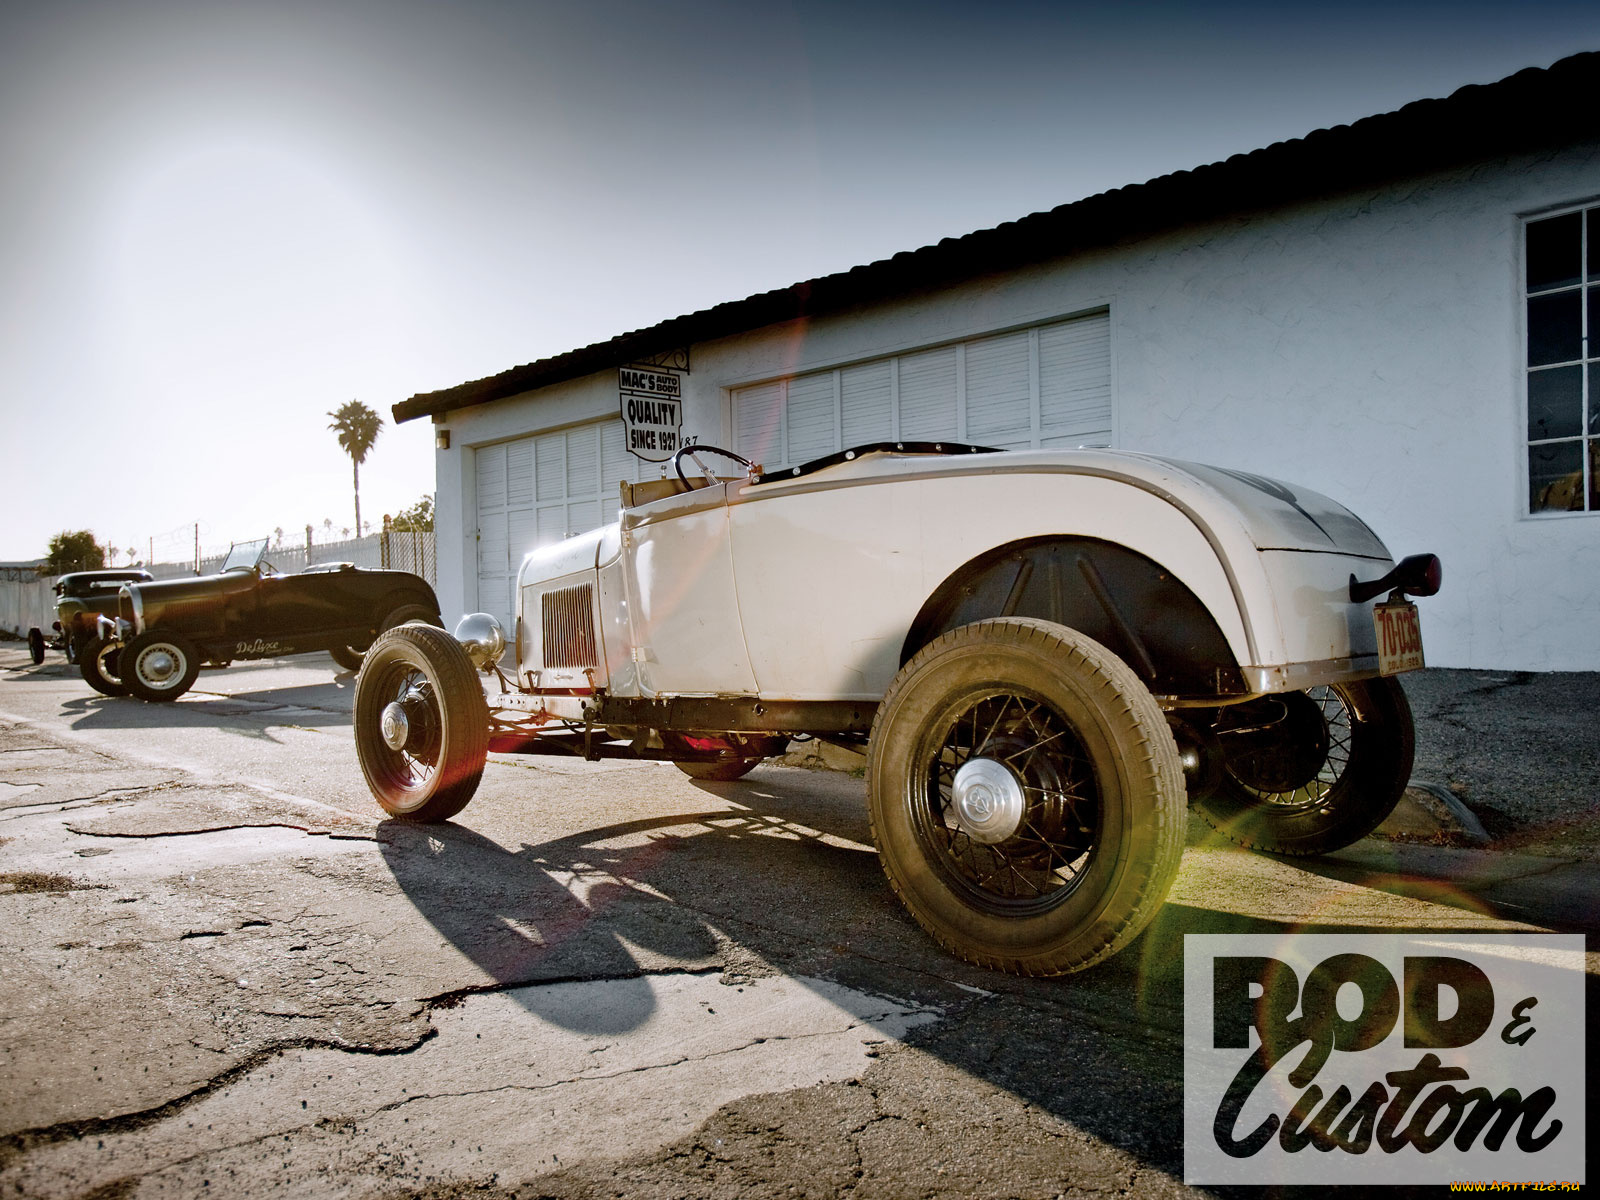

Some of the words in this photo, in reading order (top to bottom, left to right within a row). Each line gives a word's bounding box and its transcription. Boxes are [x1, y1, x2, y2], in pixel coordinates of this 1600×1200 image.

[621, 370, 656, 391] MAC'S
[656, 375, 678, 386] AUTO
[656, 384, 678, 394] BODY
[627, 399, 676, 426] QUALITY
[630, 429, 657, 450] SINCE
[659, 431, 676, 451] 1927
